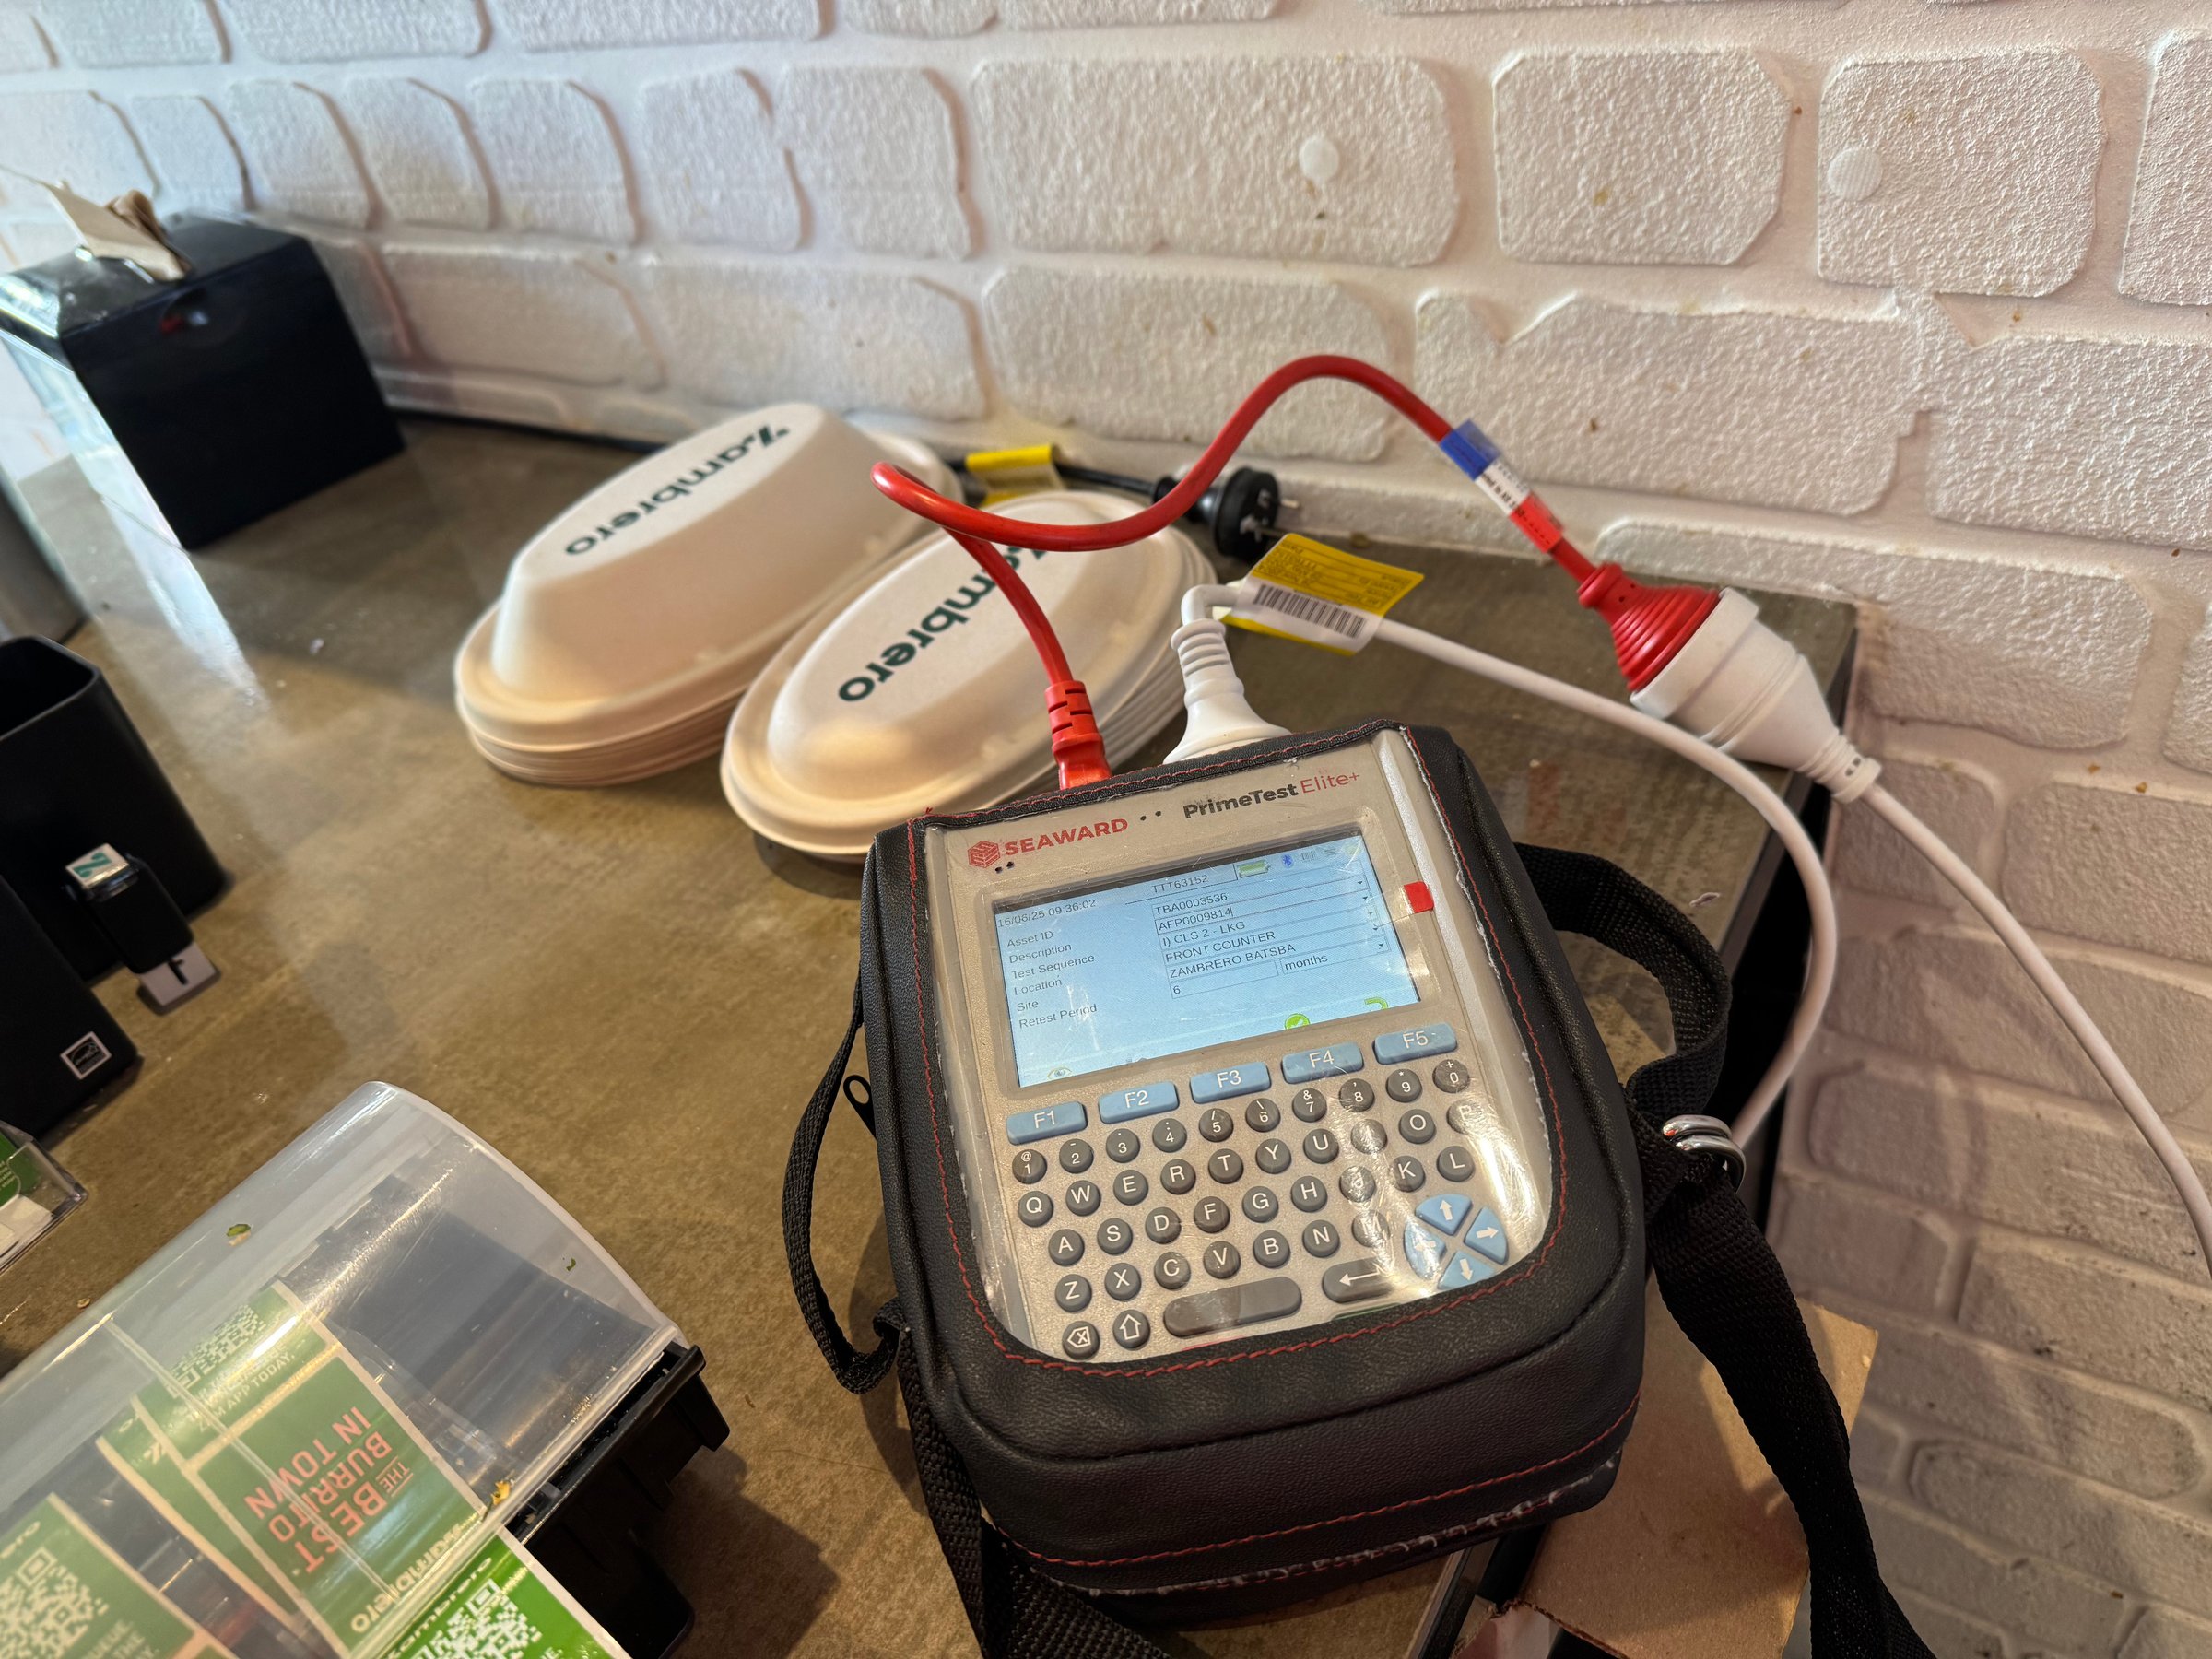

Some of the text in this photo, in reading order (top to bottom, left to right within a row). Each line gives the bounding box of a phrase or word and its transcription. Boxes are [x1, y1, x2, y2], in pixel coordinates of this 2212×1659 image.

[838, 547, 1047, 702] mbrero
[1182, 771, 1360, 819] PrimeTest Elite+
[1004, 818, 1129, 856] SEAWARD
[1152, 875, 1208, 894] TTT63152
[1155, 892, 1228, 916] TBA0003536
[998, 899, 1097, 929] 16/06/25 09:36:02
[1158, 907, 1231, 931] AFP0009814
[1006, 930, 1053, 948] Asset ID
[1173, 930, 1199, 945] CLS
[1201, 928, 1209, 939] 2
[1219, 920, 1246, 935] LKG
[1009, 943, 1073, 964] Description
[1165, 931, 1277, 963] FRONT COUNTER
[1012, 953, 1096, 980] Test Sequence
[1169, 944, 1297, 979] ZAMBRERO BATSBA
[1172, 953, 1329, 994] 6 months
[1014, 977, 1063, 996] Location
[1017, 999, 1040, 1013] Site
[1018, 1003, 1098, 1030] Retest Period
[1403, 1031, 1429, 1049] F5
[1309, 1050, 1334, 1068] F4
[1217, 1070, 1241, 1088] F3
[1402, 1081, 1411, 1093] 9
[1449, 1072, 1459, 1084] 0
[1124, 1090, 1149, 1108] F2
[1354, 1091, 1364, 1102] 8
[1305, 1101, 1314, 1112] 7
[1034, 1112, 1055, 1129] F1
[1259, 1111, 1269, 1123] 6
[1409, 1114, 1427, 1131] O
[1212, 1122, 1221, 1133] 5
[1166, 1132, 1174, 1143] 4
[1312, 1134, 1329, 1150] U
[1118, 1143, 1127, 1153] 3
[1264, 1144, 1279, 1160] Y
[1071, 1153, 1080, 1165] 2
[1217, 1154, 1231, 1171] T
[1449, 1153, 1465, 1169] L
[1024, 1164, 1031, 1174] 1
[1169, 1165, 1185, 1182] R
[1397, 1161, 1416, 1180] K
[1070, 1184, 1091, 1204] W
[1122, 1176, 1136, 1194] E
[1300, 1182, 1318, 1200] H
[1025, 1197, 1043, 1214] Q
[1252, 1193, 1270, 1210] G
[1204, 1203, 1218, 1220] F
[1154, 1214, 1170, 1232] D
[1106, 1225, 1122, 1242] S
[1312, 1226, 1331, 1244] N
[1057, 1236, 1074, 1254] A
[1263, 1237, 1279, 1255] B
[1213, 1247, 1228, 1265] V
[1162, 1259, 1181, 1277] C
[1113, 1269, 1131, 1288] X
[1065, 1281, 1080, 1300] Z
[226, 1383, 251, 1409] APP
[244, 1406, 371, 1520] IN TOWN
[268, 1430, 393, 1543] BURRITO
[294, 1460, 411, 1573] THE BEST
